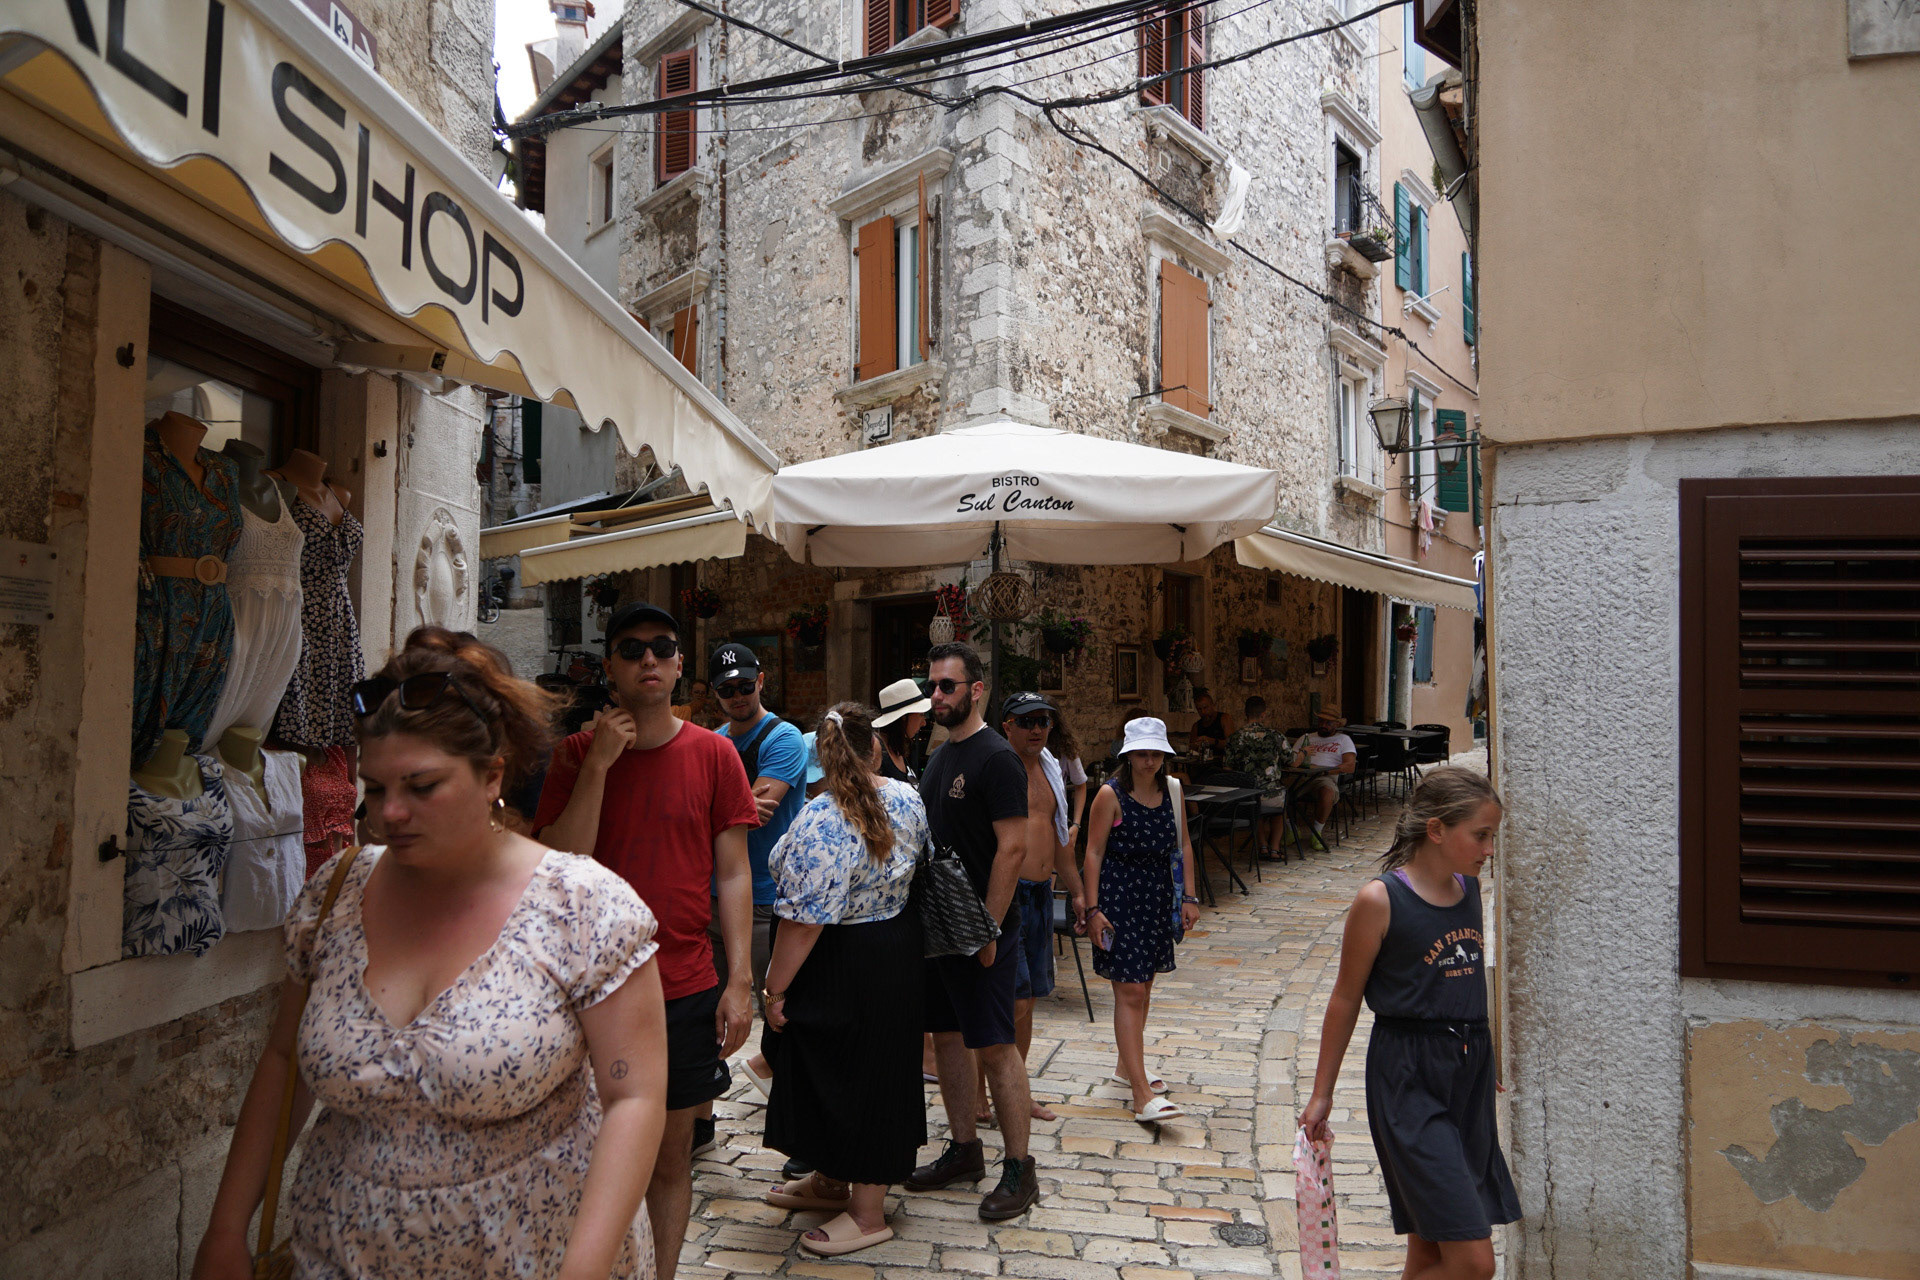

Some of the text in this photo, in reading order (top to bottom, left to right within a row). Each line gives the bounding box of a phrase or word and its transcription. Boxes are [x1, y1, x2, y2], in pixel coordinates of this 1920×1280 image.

[269, 61, 525, 325] SHOP
[992, 475, 1040, 488] BISTRO
[956, 489, 1075, 513] Sul Canton
[1424, 939, 1444, 965] SAN
